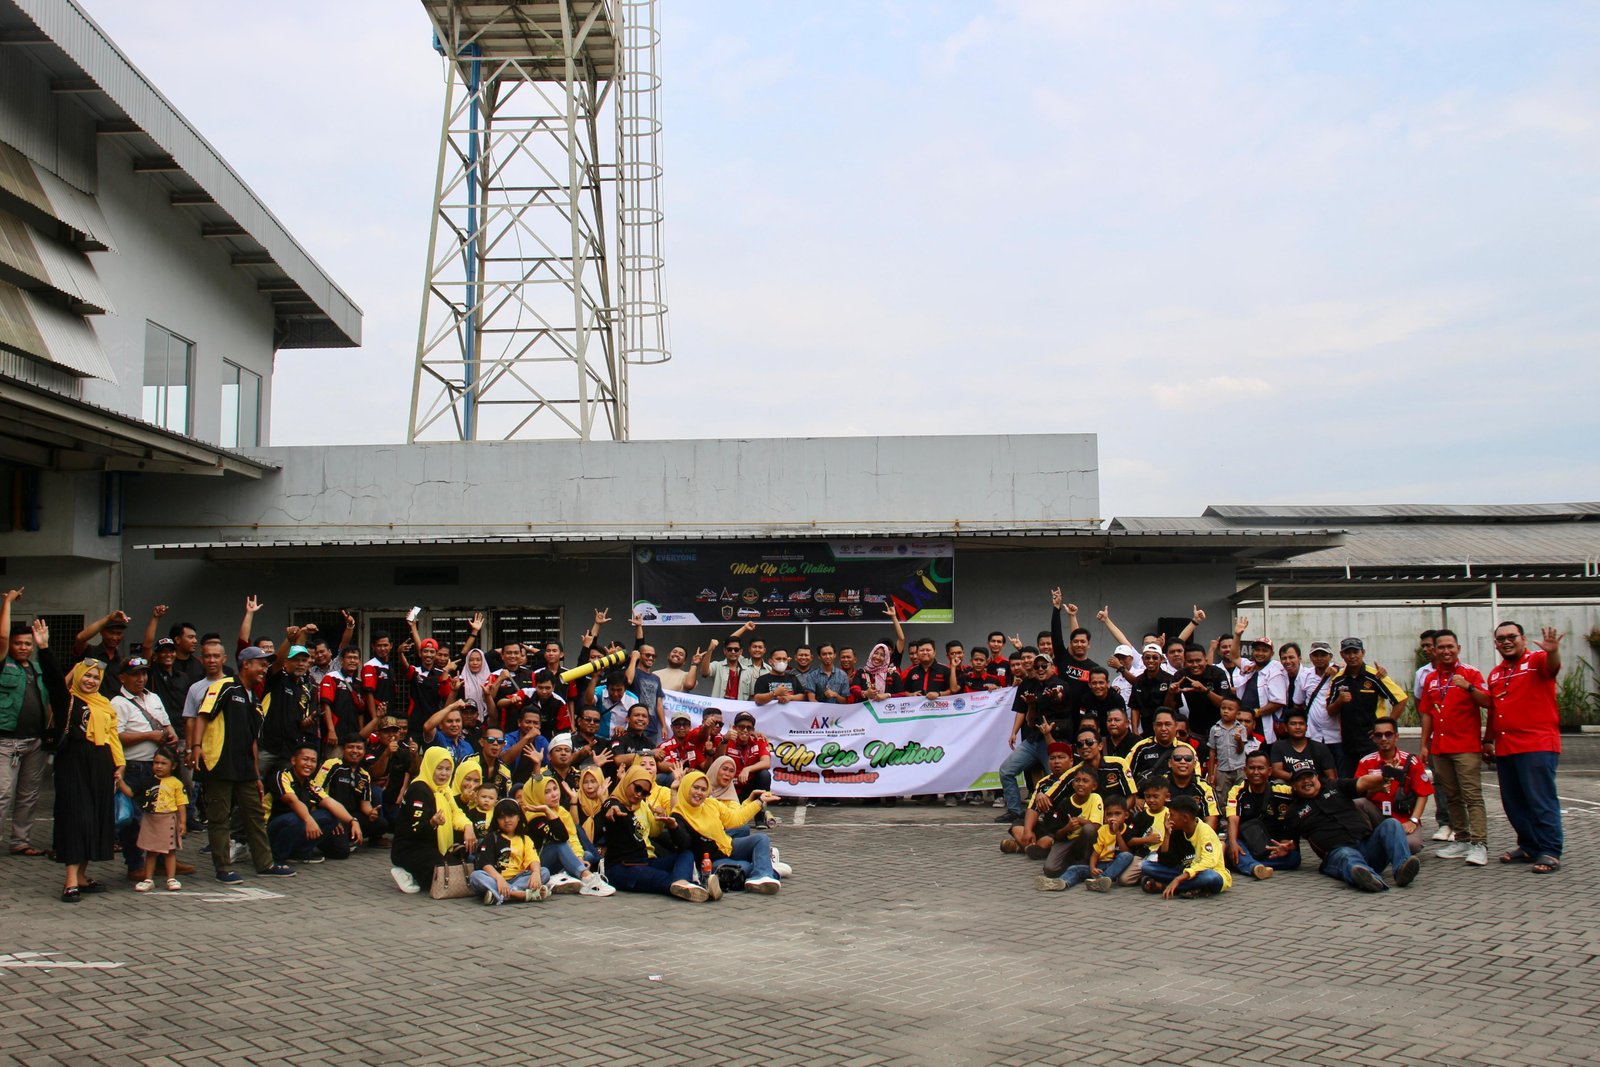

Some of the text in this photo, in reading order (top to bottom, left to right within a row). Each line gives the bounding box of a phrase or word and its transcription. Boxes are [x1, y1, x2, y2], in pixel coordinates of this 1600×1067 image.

[759, 562, 778, 577] Up
[779, 562, 798, 575] Eco
[800, 562, 837, 575] Nation
[663, 702, 705, 715] EVERYON
[775, 740, 945, 771] Up Eco Nation
